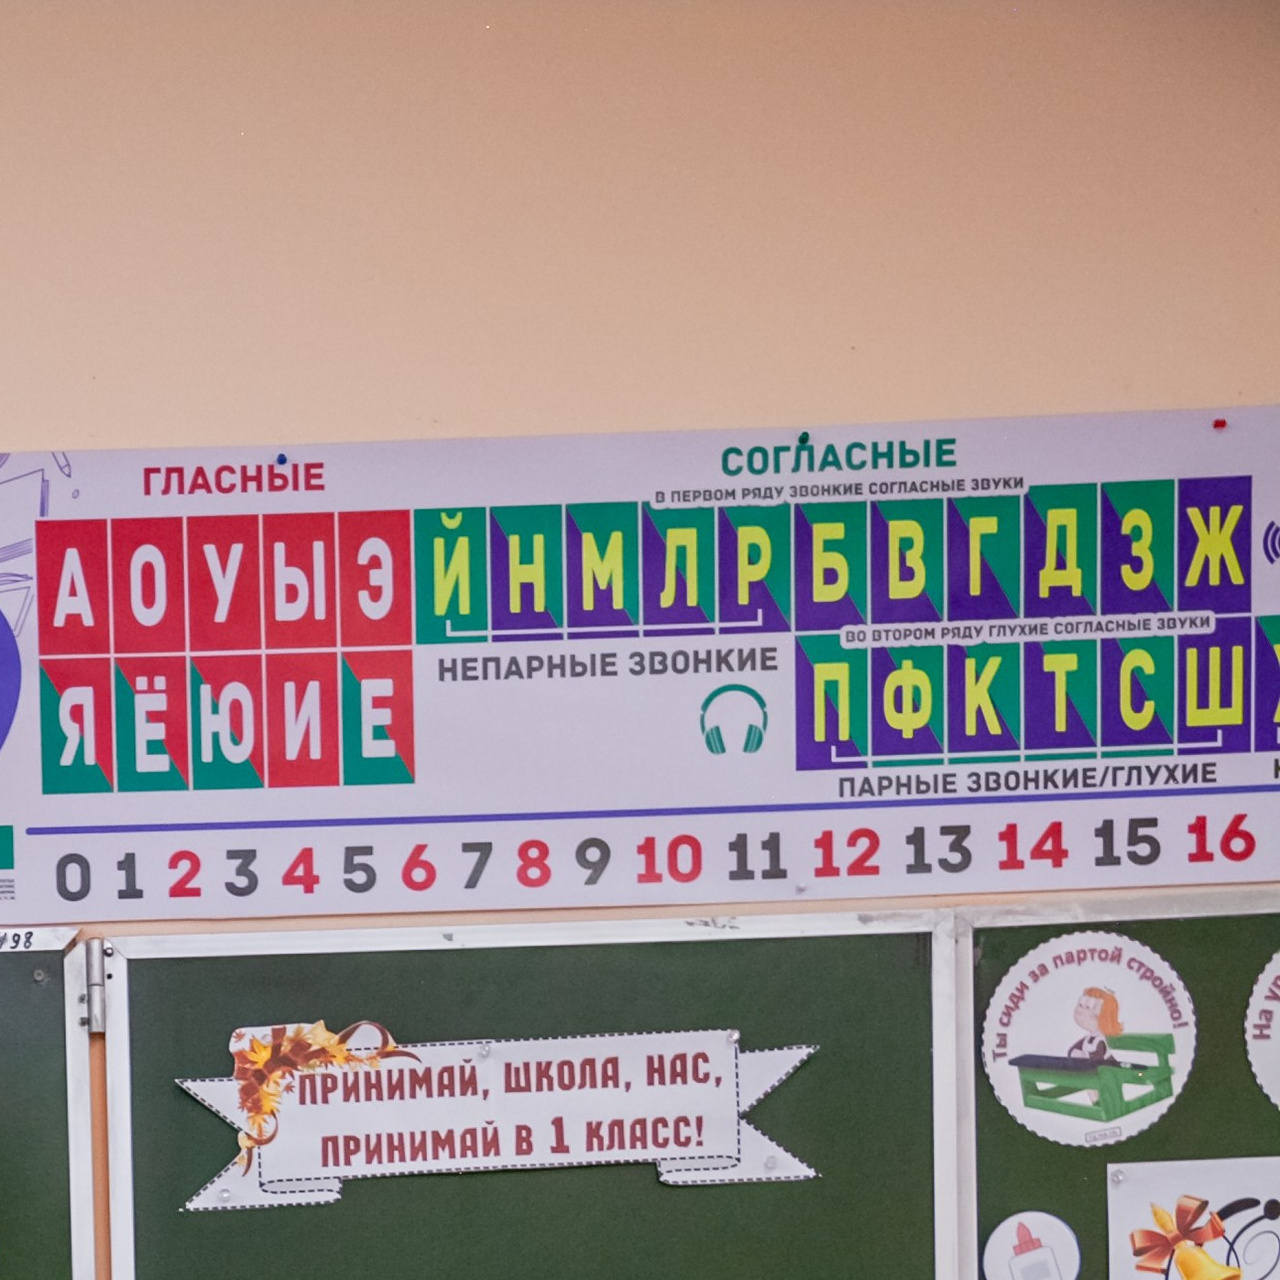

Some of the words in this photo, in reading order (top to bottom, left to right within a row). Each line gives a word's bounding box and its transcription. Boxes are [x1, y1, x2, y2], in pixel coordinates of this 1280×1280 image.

[143, 463, 325, 496] ГЛАСНЫЕ
[721, 438, 957, 477] СОГЛАСНЫЕ
[655, 491, 666, 504] В
[670, 489, 736, 504] ПЕРВОМ
[741, 486, 785, 501] РЯДУ
[789, 483, 863, 498] ЗВОНКИЕ
[869, 479, 966, 495] СОГЛАСНЫЕ
[970, 476, 1024, 492] ЗВУКИ
[53, 548, 94, 627] А
[130, 544, 167, 626] О
[203, 543, 243, 623] У
[274, 541, 326, 621] Ы
[357, 537, 393, 620] Э
[433, 511, 471, 616] Й
[508, 533, 545, 613] Н
[581, 531, 624, 611] М
[659, 528, 698, 608] Л
[737, 525, 772, 605] Р
[812, 522, 849, 603] Б
[888, 519, 926, 600] В
[969, 516, 998, 596] Г
[1039, 508, 1082, 598] Д
[1120, 508, 1154, 591] З
[1184, 505, 1245, 587] Ж
[845, 630, 867, 643] ВО
[872, 627, 935, 643] ВТОРОМ
[941, 625, 984, 641] РЯДУ
[989, 623, 1049, 638] ГЛУХИЕ
[1054, 619, 1151, 636] СОГЛАСНЫЕ
[1157, 616, 1211, 631] ЗВУКИ
[438, 653, 618, 682] НЕПАРНЫЕ
[628, 647, 778, 676] ЗВОНКИЕ
[813, 662, 850, 742] П
[882, 659, 933, 739] Ф
[964, 656, 1003, 736] К
[1043, 653, 1078, 732] Т
[1120, 648, 1155, 732] С
[1186, 645, 1244, 727] Ш
[59, 686, 97, 767] Я
[135, 676, 170, 772] Ё
[200, 681, 254, 764] Ю
[284, 680, 321, 760] И
[360, 678, 396, 758] Е
[838, 773, 958, 798] ПАРНЫЕ
[966, 762, 1218, 793] ЗВОНКИЕ/ГЛУХИЕ
[56, 853, 91, 901] 0
[116, 853, 143, 899] 1
[168, 851, 201, 898] 2
[224, 849, 258, 897] 3
[282, 847, 320, 894] 4
[343, 846, 376, 893] 5
[401, 844, 436, 892] 6
[461, 842, 493, 889] 7
[516, 839, 551, 888] 8
[575, 837, 611, 885] 9
[636, 834, 702, 884] 10
[728, 832, 787, 881] 11
[814, 828, 880, 877] 12
[905, 825, 972, 874] 13
[998, 821, 1068, 871] 14
[1094, 817, 1160, 866] 15
[1187, 814, 1256, 863] 16
[992, 1032, 1008, 1062] Ты
[1000, 980, 1030, 1028] сиди
[1028, 963, 1050, 984] за
[1052, 946, 1124, 970] партой
[1126, 957, 1189, 1030] стройно!
[1252, 1009, 1274, 1040] На
[298, 1059, 490, 1106] ПРИНИМАЙ,
[504, 1056, 632, 1093] ШКОЛА,
[646, 1052, 722, 1088] НАС,
[322, 1121, 500, 1168] ПРИНИМАЙ
[515, 1124, 534, 1156] В
[550, 1116, 570, 1154] 1
[586, 1115, 705, 1152] КЛАСС!
